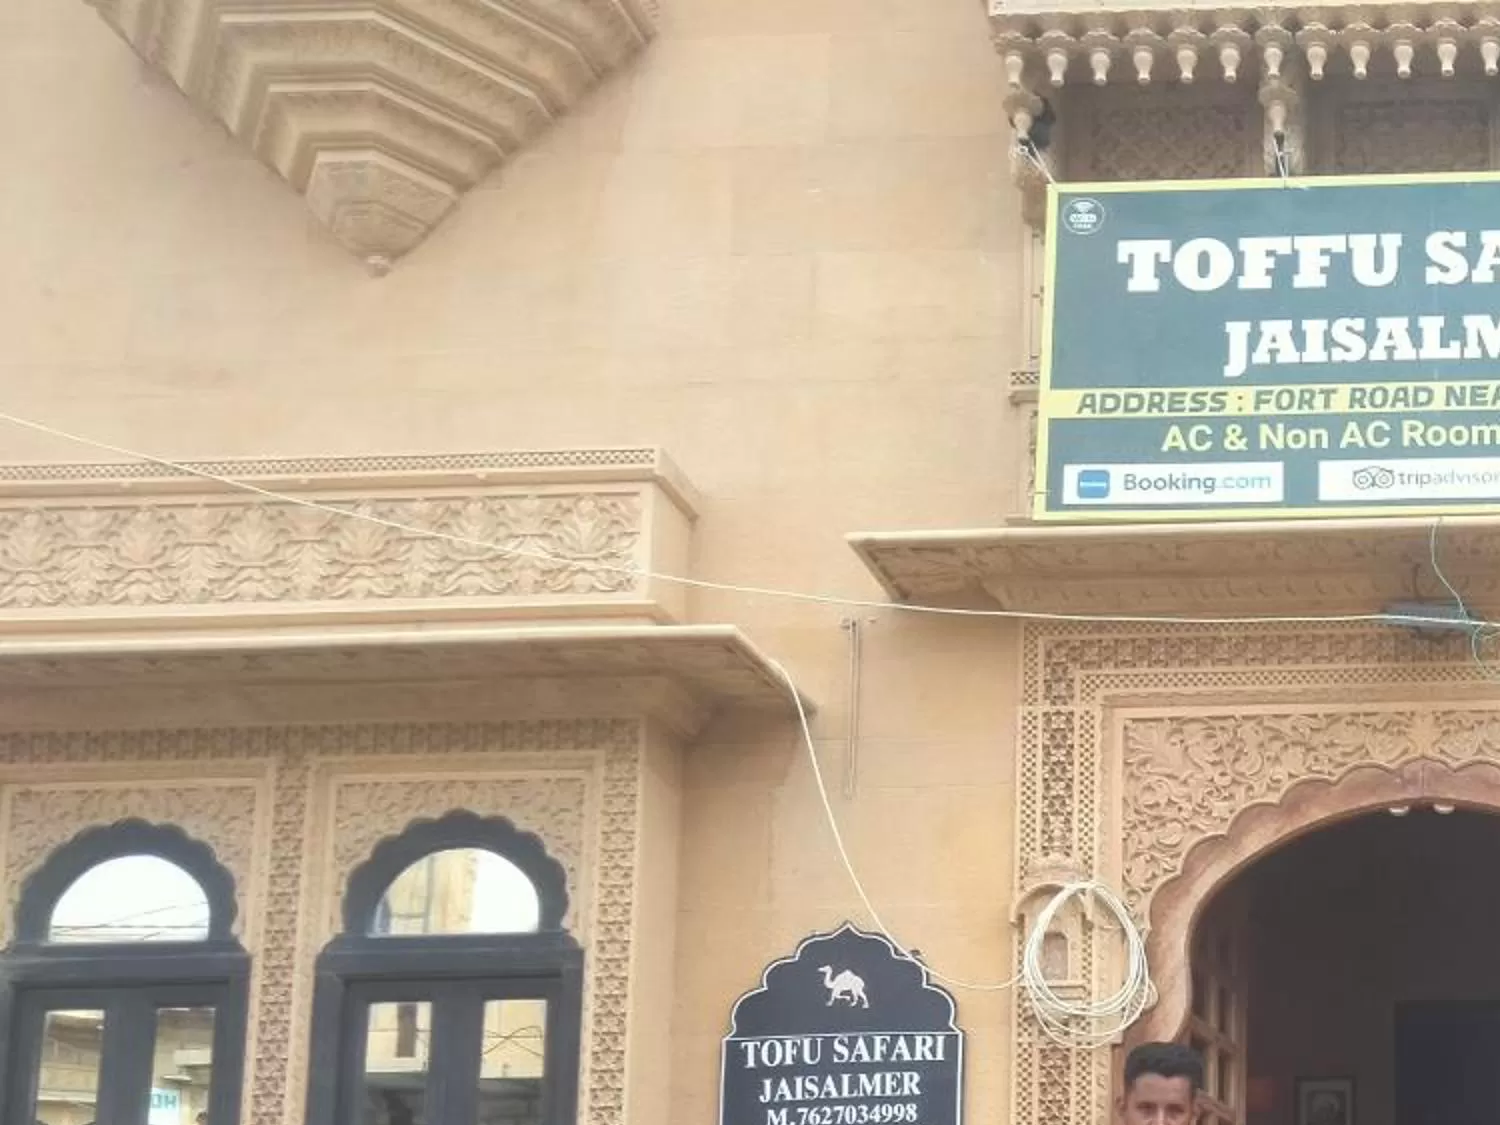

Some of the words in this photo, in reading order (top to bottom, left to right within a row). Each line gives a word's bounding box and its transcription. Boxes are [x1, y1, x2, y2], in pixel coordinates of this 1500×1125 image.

[1116, 233, 1402, 293] TOFFU
[1254, 387, 1337, 411] FORT
[1348, 385, 1434, 409] ROAD
[1160, 424, 1213, 452] AC
[1223, 423, 1249, 451] &
[1259, 422, 1329, 450] Non
[1339, 420, 1391, 448] AC
[1123, 473, 1272, 494] Booking.com
[1398, 467, 1500, 488] tripadvisor
[741, 1038, 824, 1068] TOFU
[833, 1035, 945, 1063] SAFARI
[759, 1071, 921, 1103] JAISALMER
